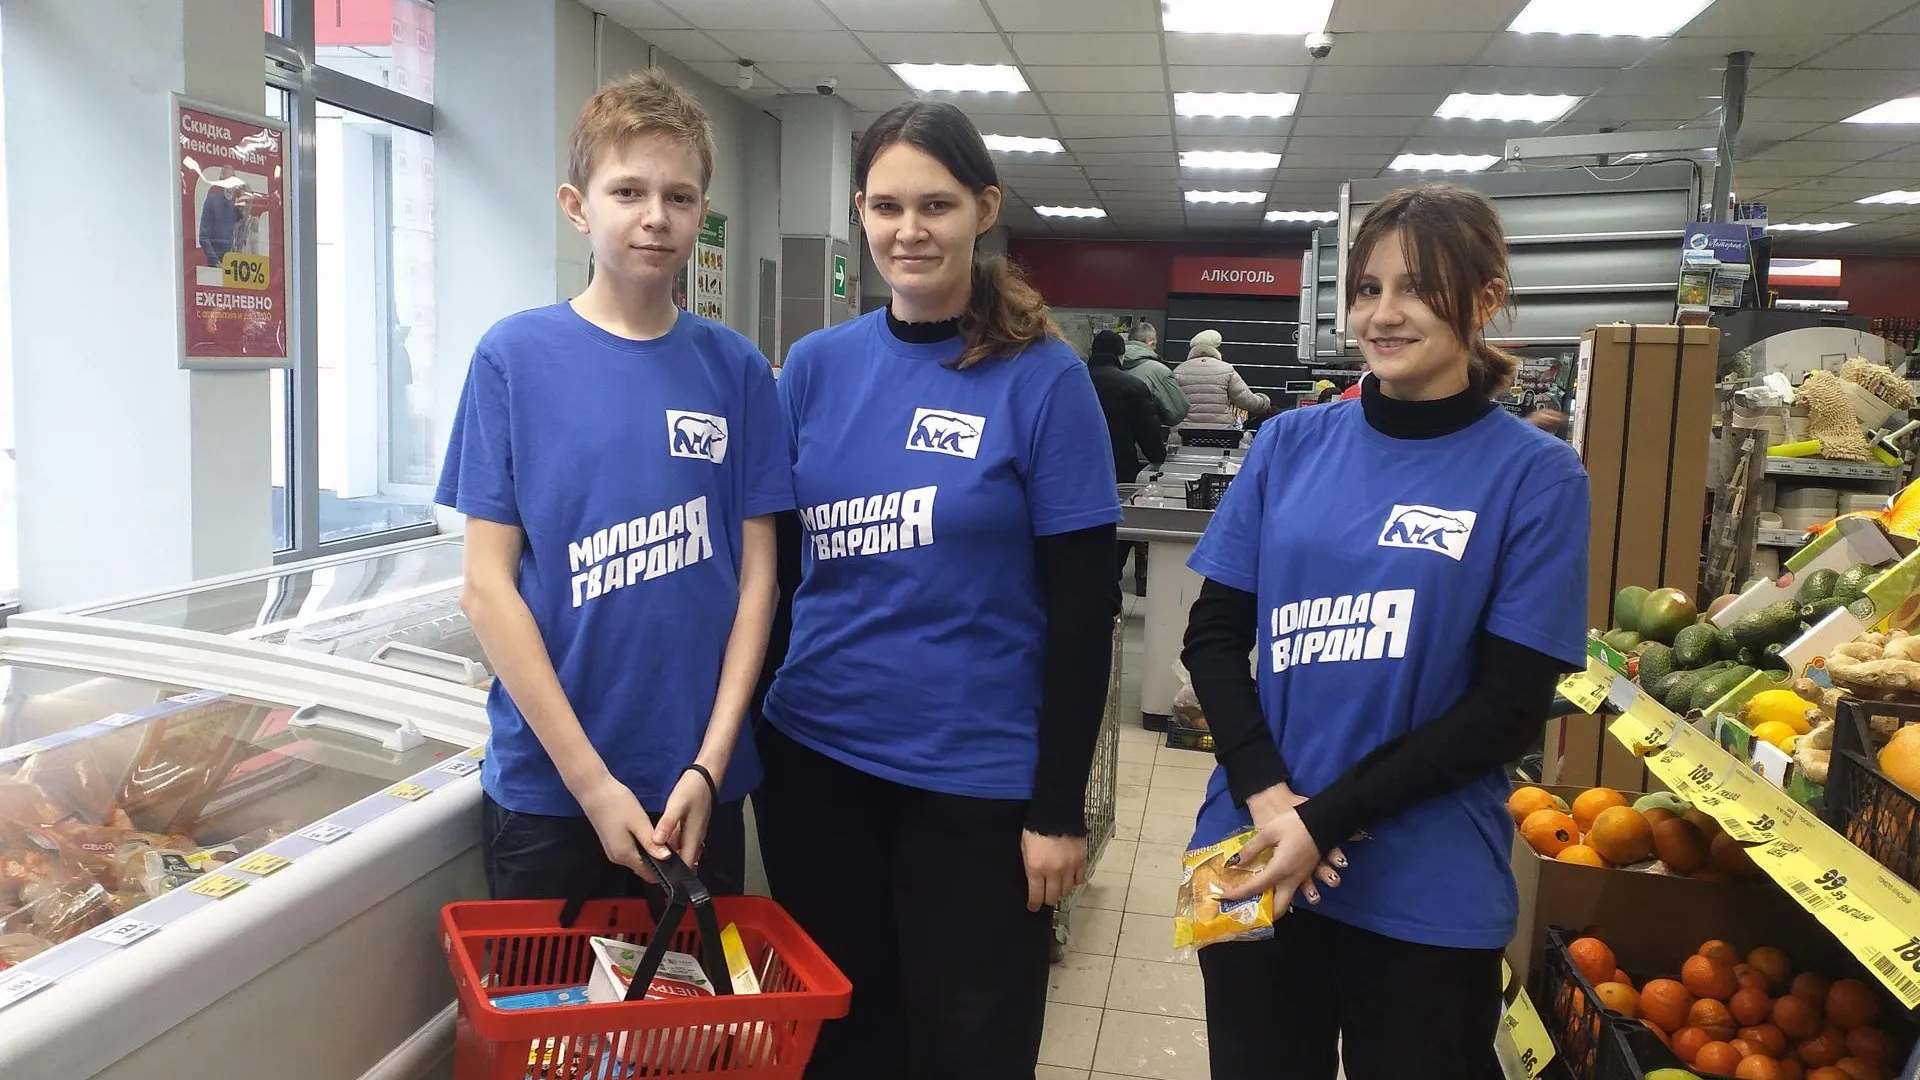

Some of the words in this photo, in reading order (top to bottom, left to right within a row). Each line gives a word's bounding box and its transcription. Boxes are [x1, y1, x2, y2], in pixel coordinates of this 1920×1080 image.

[182, 114, 231, 140] Скидка
[225, 258, 265, 284] -10%
[1200, 268, 1275, 284] АЛКОГОЛЬ
[195, 292, 272, 310] ЕЖЕДНЕВНО
[798, 485, 937, 546] МОЛОДАЯ
[568, 495, 713, 572] МОЛОДАЯ
[1271, 612, 1413, 674] ВАРДИЯ
